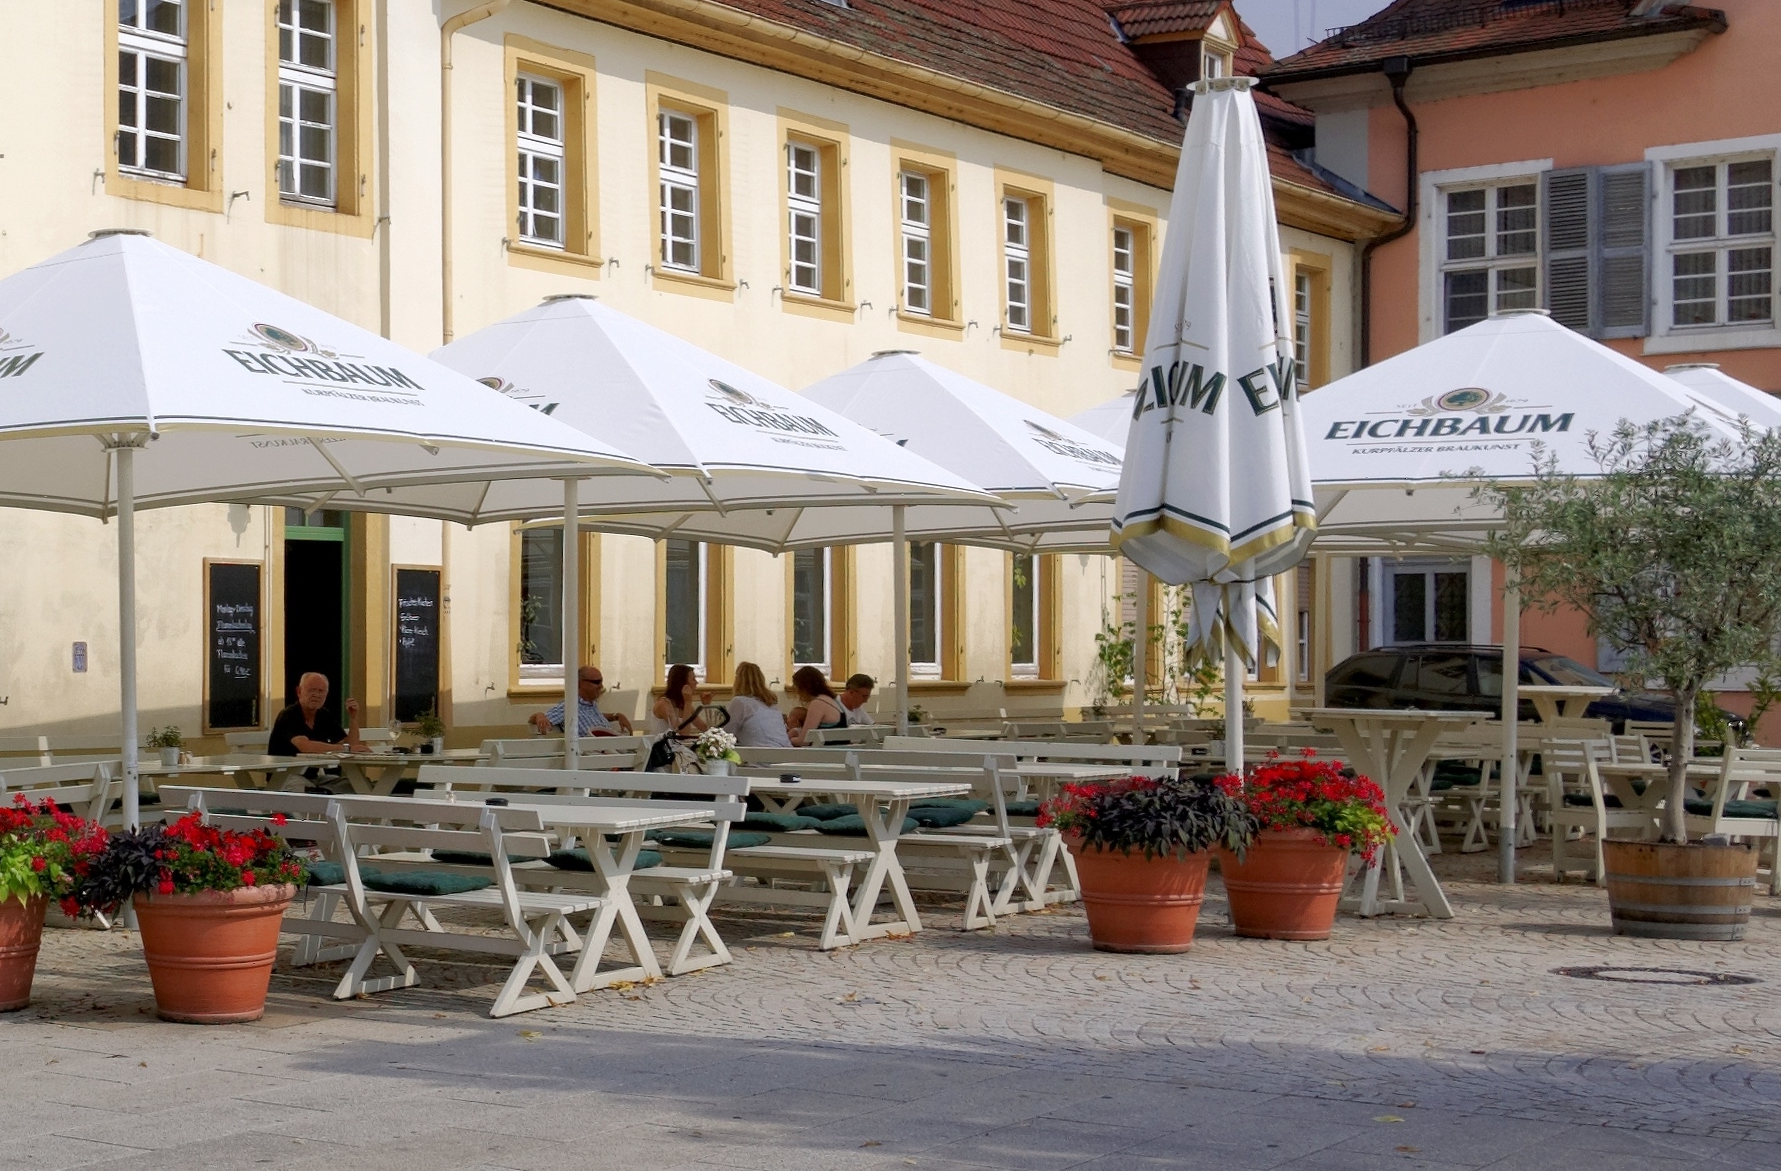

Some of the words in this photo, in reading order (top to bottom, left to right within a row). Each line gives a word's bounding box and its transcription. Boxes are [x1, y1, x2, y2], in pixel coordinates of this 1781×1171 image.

[221, 348, 426, 391] EICHBAUM
[704, 402, 840, 438] EICHBAUM
[1323, 412, 1576, 440] EICHBAUM
[1351, 444, 1434, 455] KURPFÄLZER
[1436, 443, 1522, 453] BRAUKUNST
